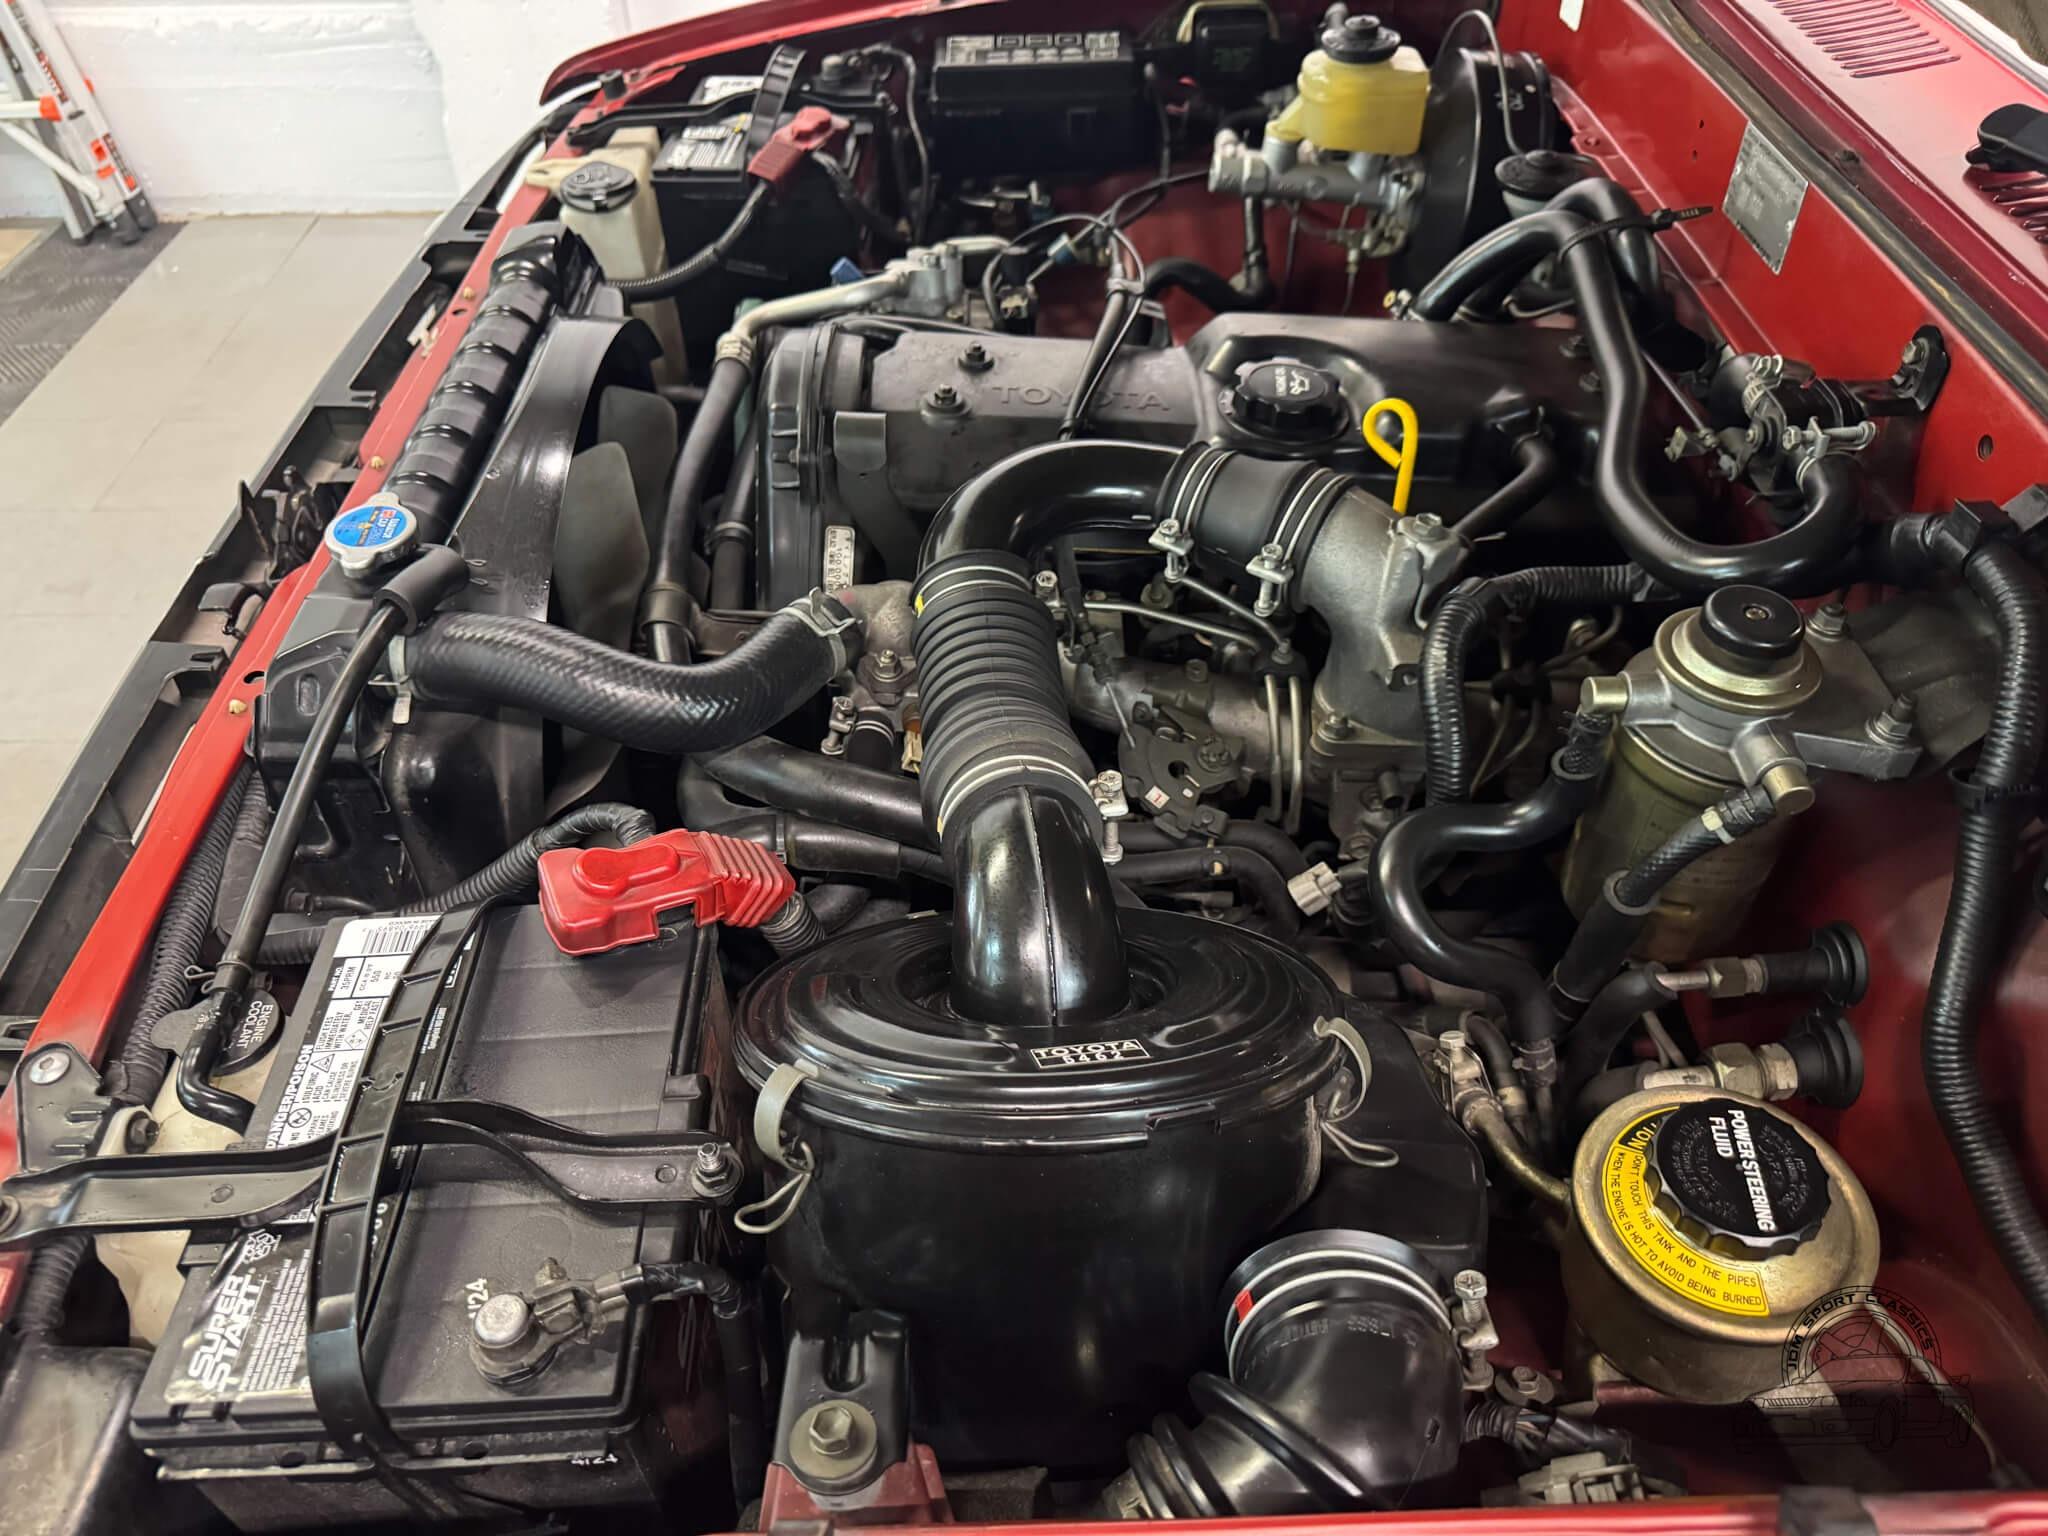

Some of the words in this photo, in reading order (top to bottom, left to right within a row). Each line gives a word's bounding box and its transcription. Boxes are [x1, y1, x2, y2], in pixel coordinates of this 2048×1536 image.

[992, 385, 1171, 411] TOYTA
[340, 966, 357, 990] 35PRM
[236, 1000, 263, 1049] COOLANT
[251, 1004, 274, 1043] ENGINE
[325, 1011, 344, 1050] IMMEDIATELY
[1033, 1040, 1139, 1059] TOYOTA
[265, 1044, 313, 1149] DANGER/POISON
[302, 1072, 320, 1101] SULFURIC
[313, 1085, 324, 1100] ACID
[1709, 1116, 1735, 1158] FLUID
[1728, 1110, 1757, 1160] POWER
[1611, 1173, 1620, 1189] THE
[1742, 1159, 1777, 1232] STEERING
[1611, 1190, 1629, 1219] ENGINE
[1623, 1221, 1634, 1232] IS
[1629, 1231, 1648, 1248] HOT
[1630, 1179, 1641, 1207] TOUCH
[1638, 1209, 1655, 1230] THIS
[1652, 1231, 1676, 1253] TANK
[1676, 1253, 1697, 1268] AND
[1702, 1265, 1721, 1281] THE
[1727, 1273, 1757, 1288] PIPES
[1645, 1248, 1658, 1261] TO
[1656, 1260, 1685, 1283] AVOID
[1687, 1278, 1717, 1298] BEING
[1722, 1291, 1762, 1306] BURNED
[188, 1274, 243, 1378] SUPER
[200, 1274, 261, 1392] START
